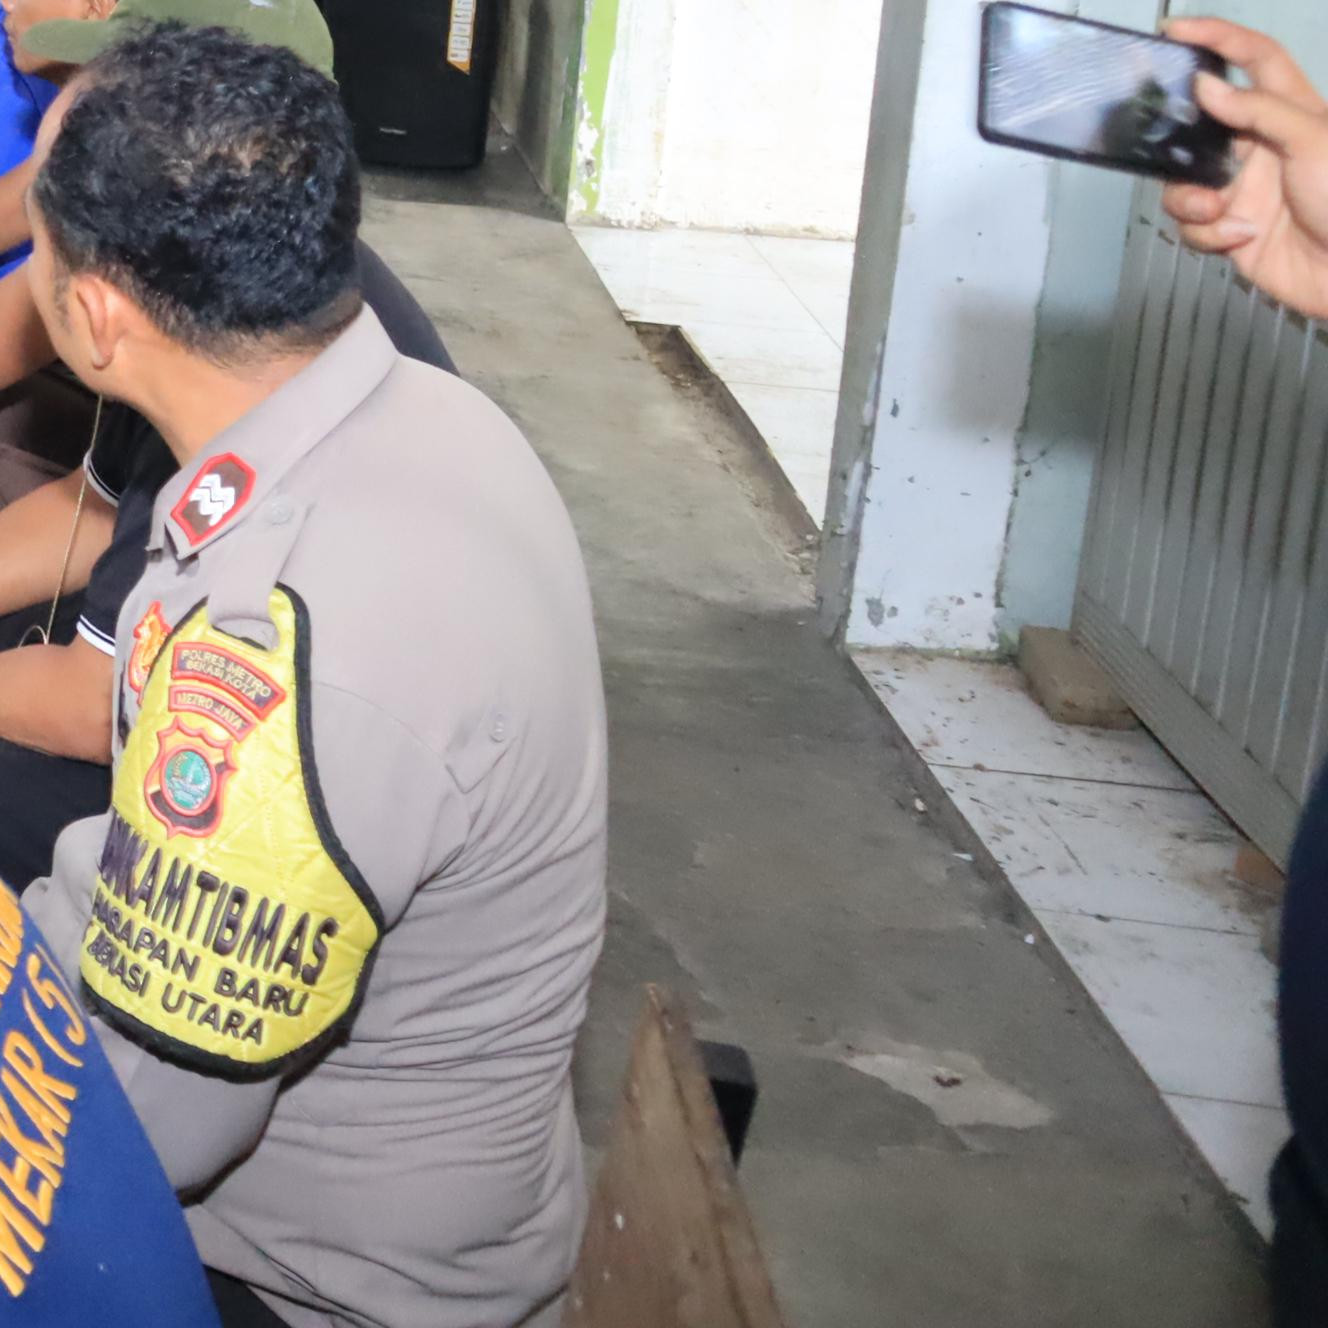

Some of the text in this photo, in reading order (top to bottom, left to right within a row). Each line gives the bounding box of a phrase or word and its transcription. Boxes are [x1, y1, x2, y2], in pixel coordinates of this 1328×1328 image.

[180, 648, 272, 699] POLRES METRO
[224, 672, 258, 701] KOTA
[175, 691, 247, 731] METRO JAYA
[160, 980, 268, 1047] UTARA
[215, 966, 310, 1018] BARU
